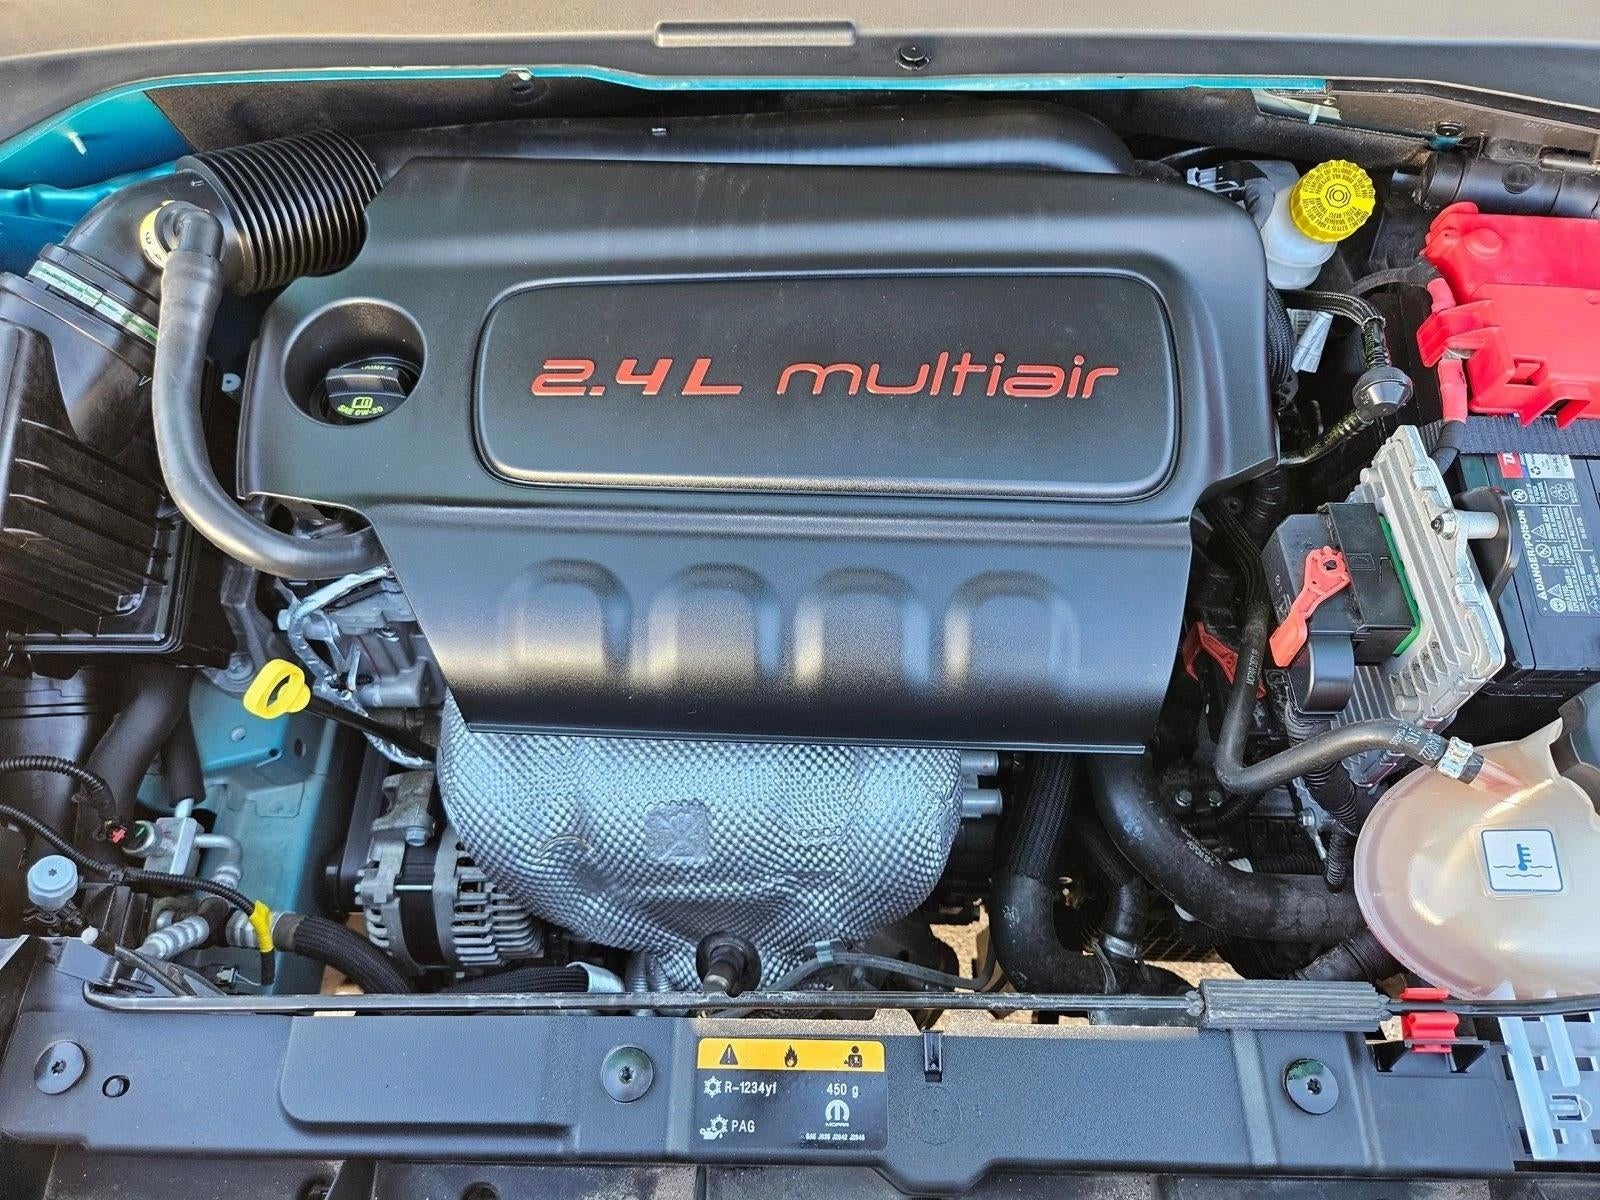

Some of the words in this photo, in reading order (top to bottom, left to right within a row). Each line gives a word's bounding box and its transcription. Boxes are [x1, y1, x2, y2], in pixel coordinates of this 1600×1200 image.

[776, 352, 1119, 399] multiair
[337, 404, 354, 415] SAE
[354, 405, 384, 416] 0W-20
[1517, 510, 1544, 590] DANGER/POISON
[724, 1081, 777, 1096] R-1234yf
[826, 1083, 847, 1096] 450
[852, 1086, 859, 1098] g
[731, 1120, 755, 1132] PAG
